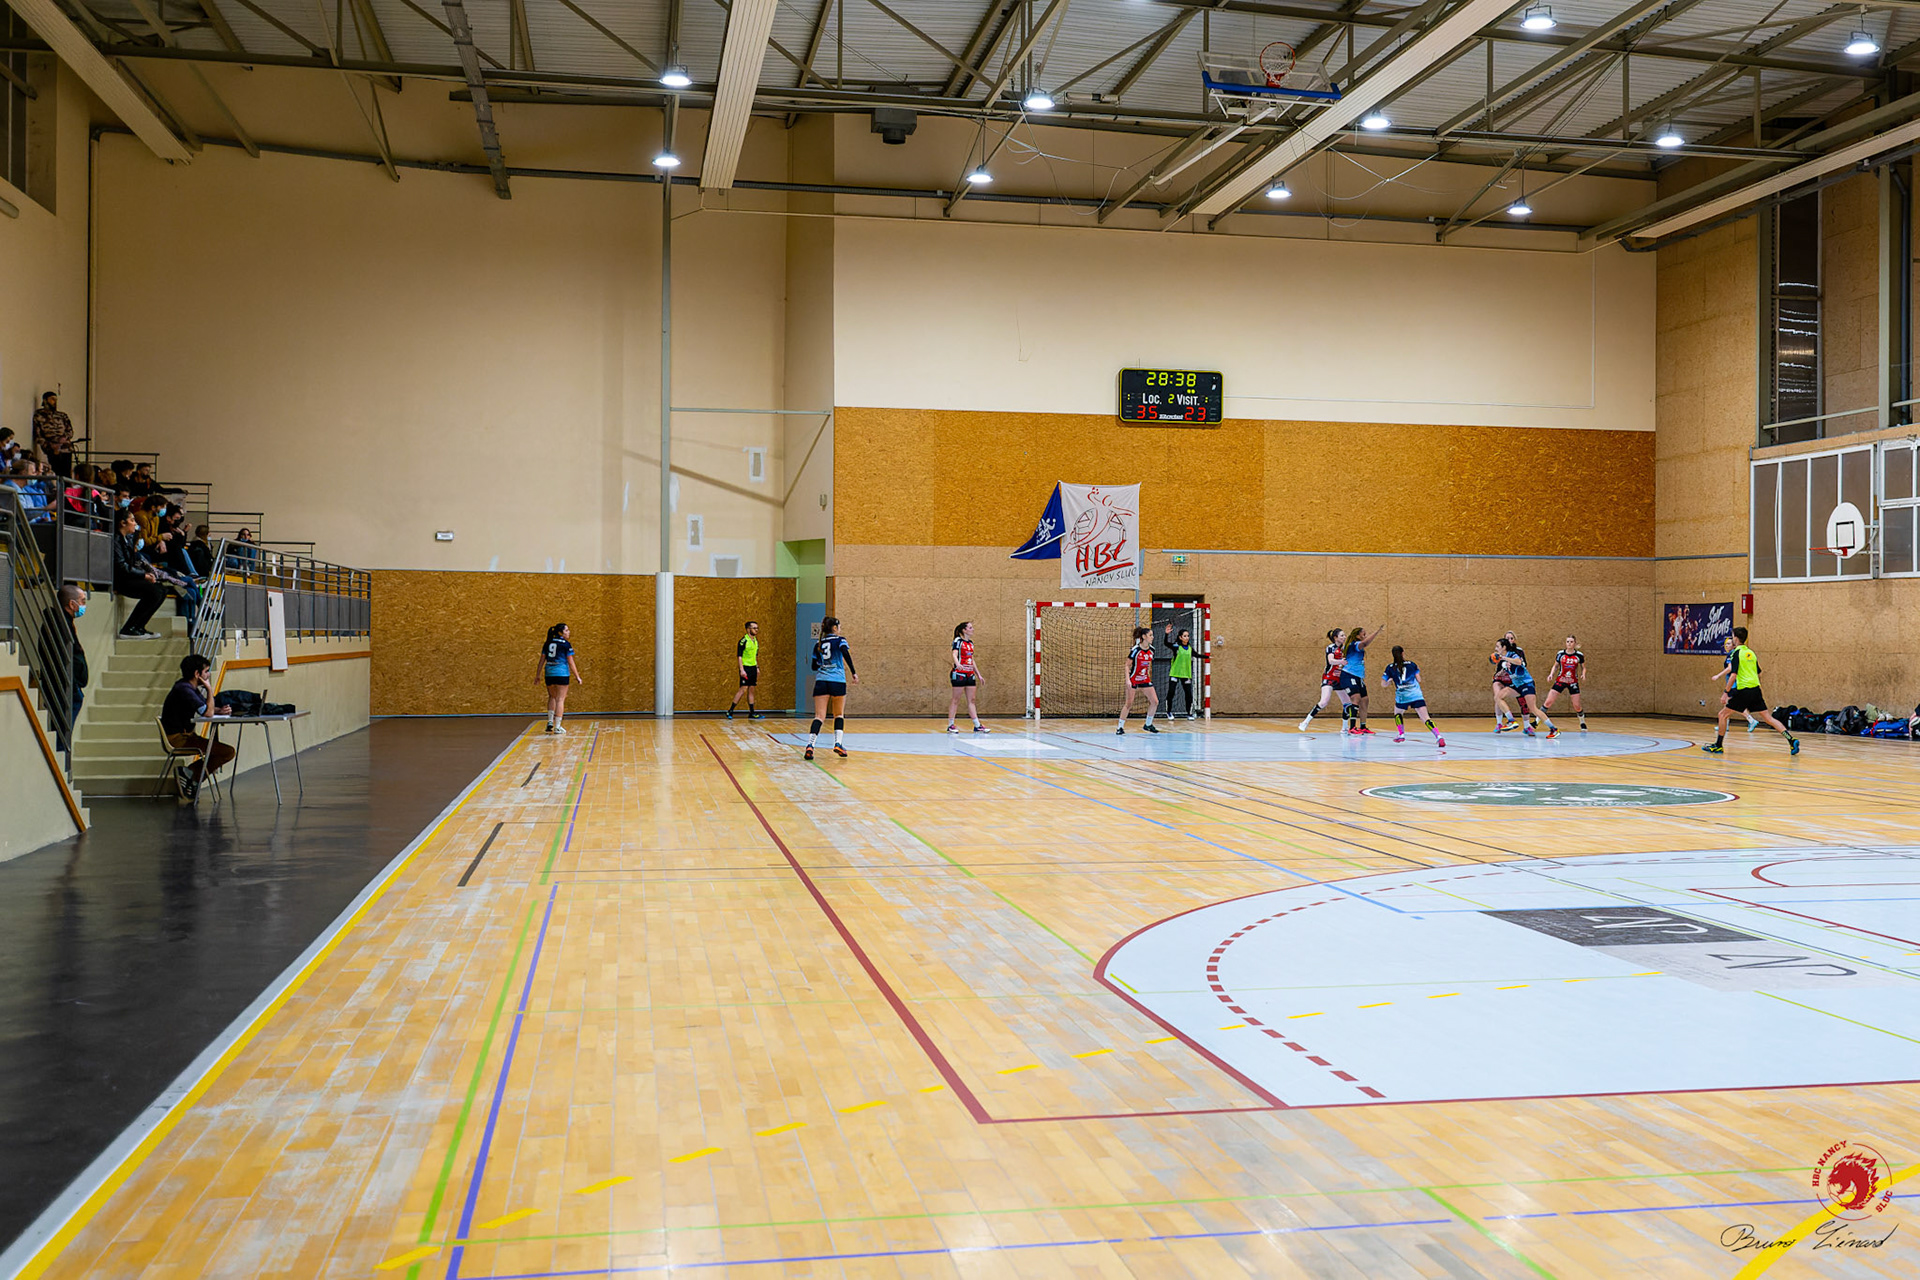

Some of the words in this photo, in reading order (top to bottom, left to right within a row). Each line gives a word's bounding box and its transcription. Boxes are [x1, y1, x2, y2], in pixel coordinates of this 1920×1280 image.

[1146, 372, 1197, 387] 28:38
[1142, 393, 1162, 404] LOC.
[1168, 394, 1175, 403] 2
[1177, 394, 1200, 405] VISIT.
[1137, 405, 1158, 419] 35
[1184, 406, 1206, 421] 23
[1076, 540, 1131, 572] HBC
[1085, 575, 1115, 587] NANCY
[1116, 567, 1137, 580] SLUC
[548, 643, 557, 658] 9
[821, 642, 832, 660] 3
